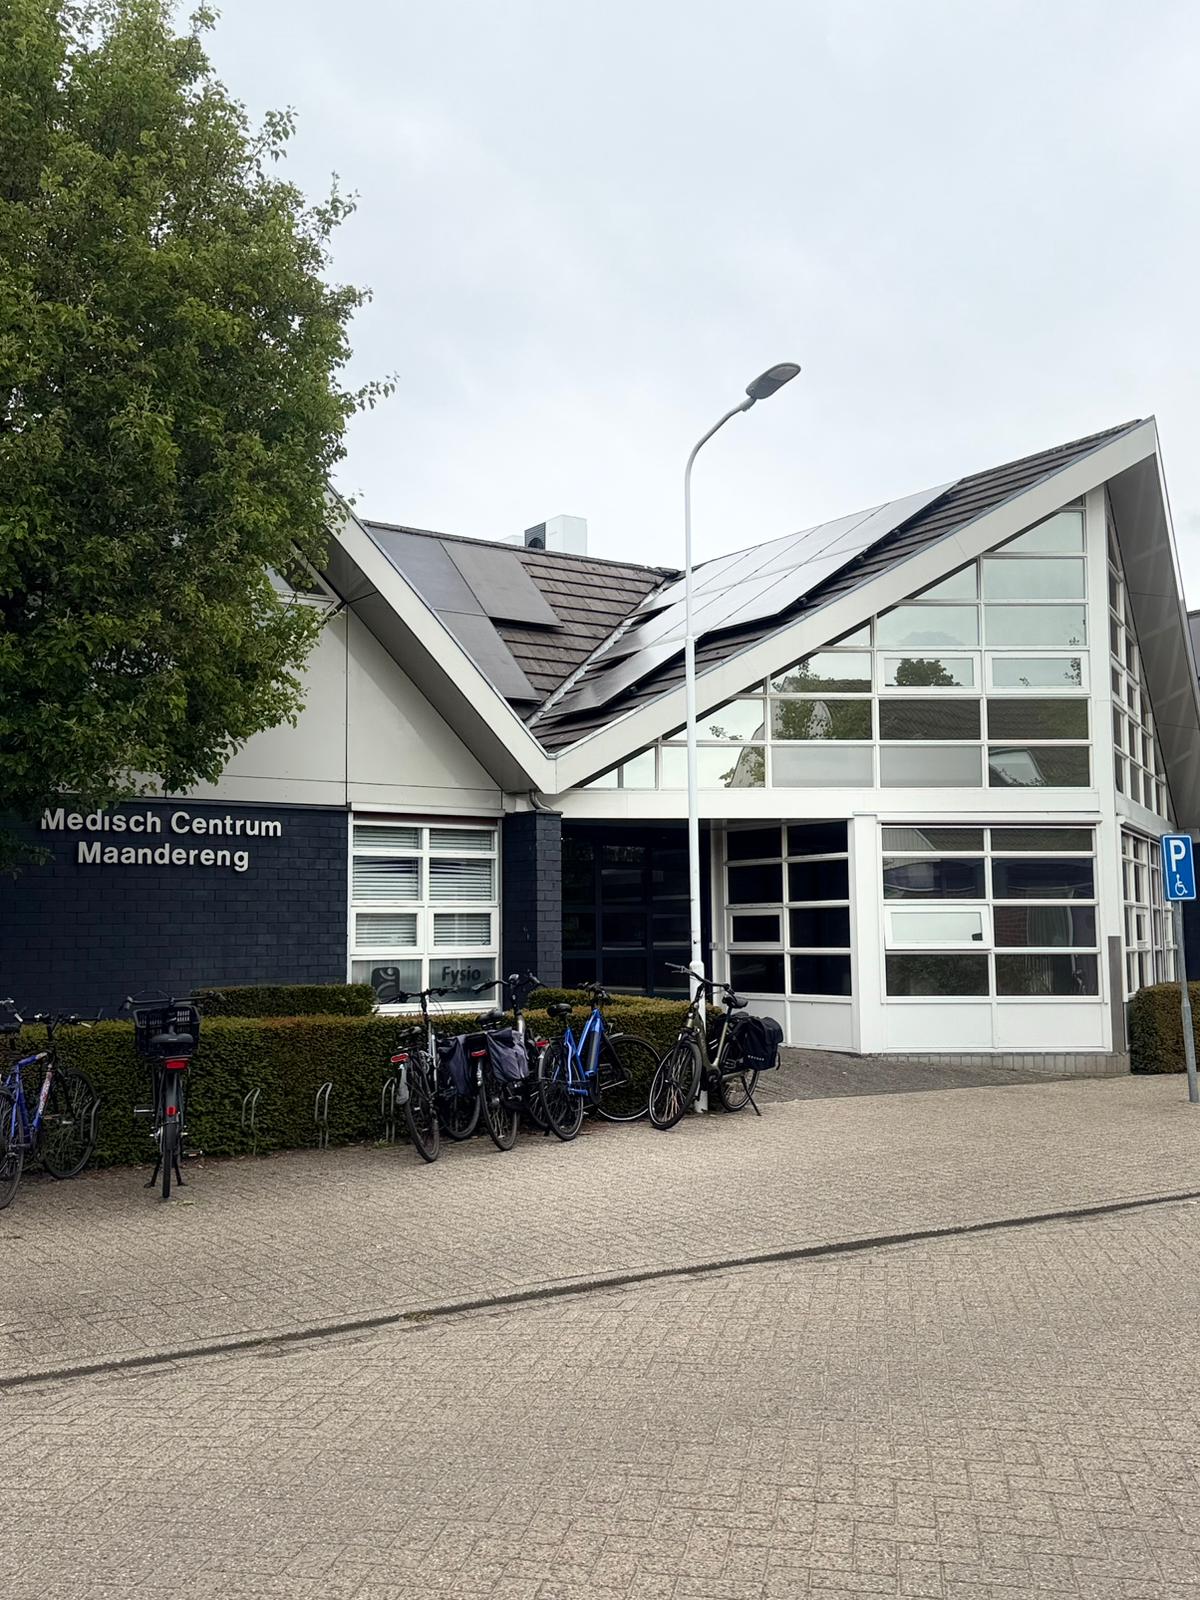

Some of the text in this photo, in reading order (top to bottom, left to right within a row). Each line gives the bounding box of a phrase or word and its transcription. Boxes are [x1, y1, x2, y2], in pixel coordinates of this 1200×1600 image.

[41, 808, 282, 836] Medisch Centrum
[78, 841, 249, 872] Maandereng
[1169, 839, 1186, 872] P
[441, 965, 481, 986] Fysio
